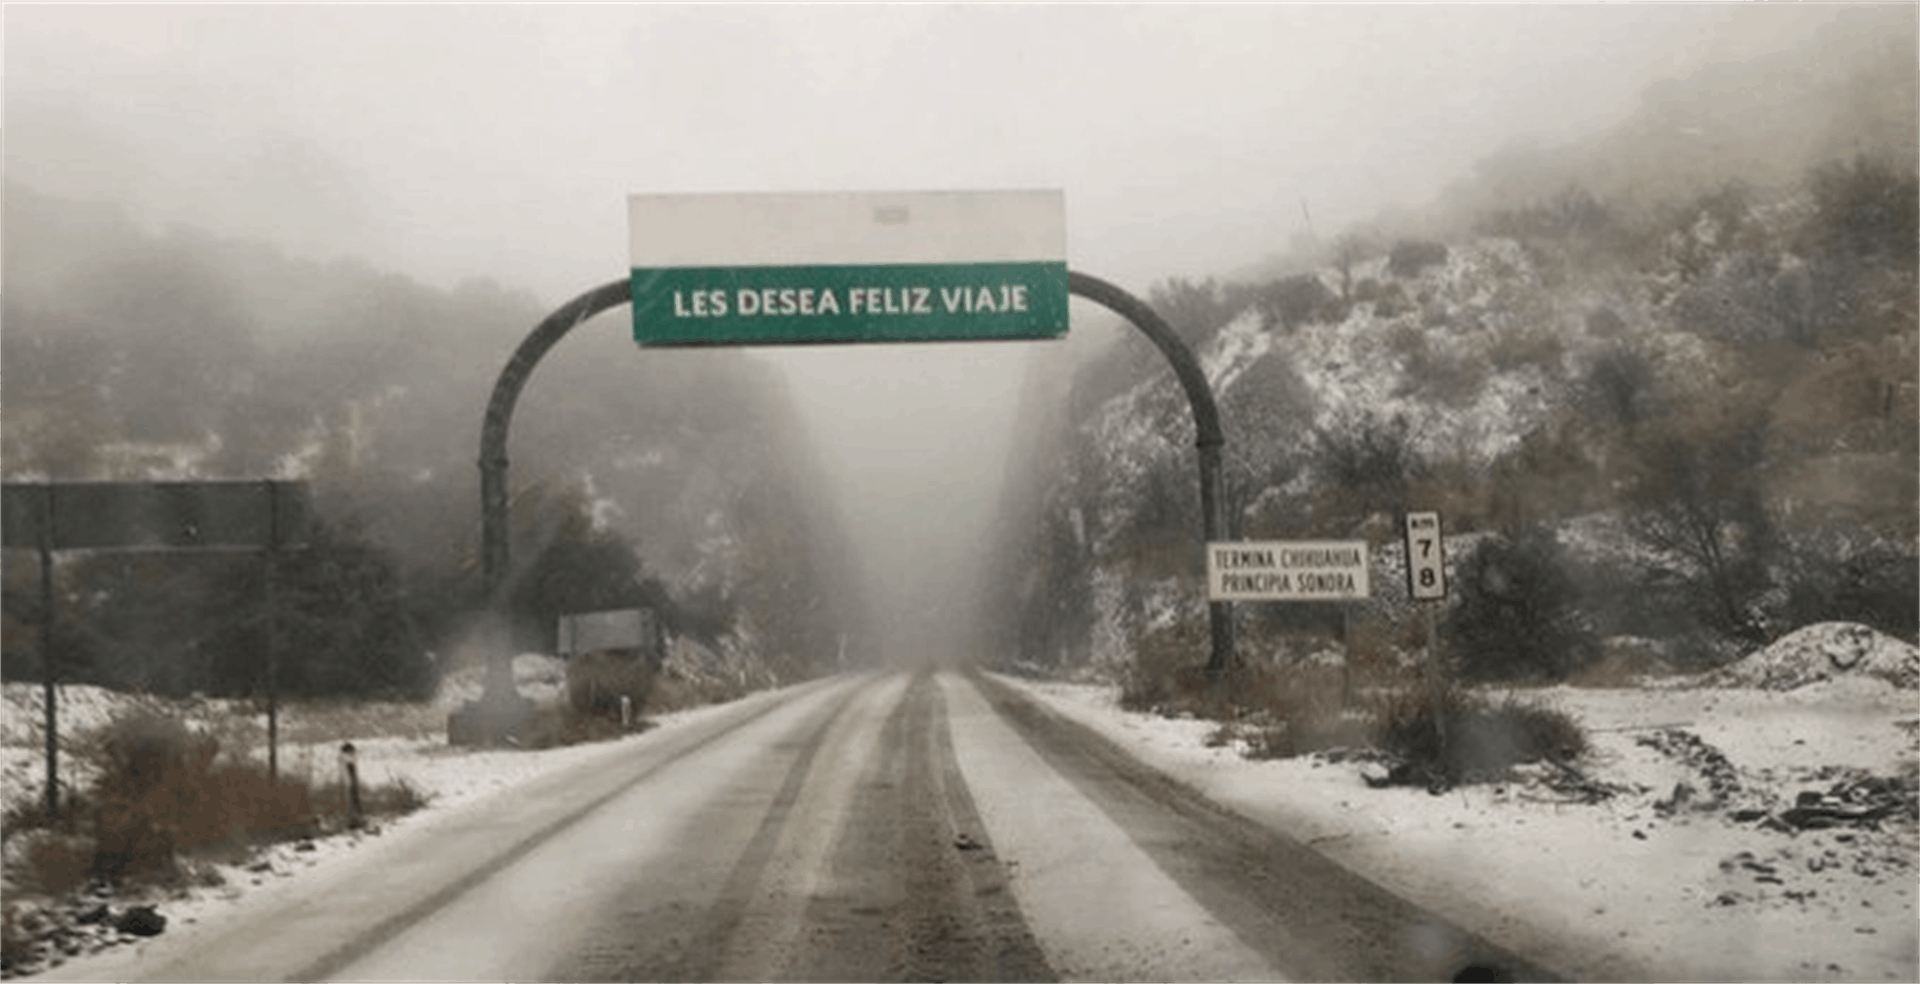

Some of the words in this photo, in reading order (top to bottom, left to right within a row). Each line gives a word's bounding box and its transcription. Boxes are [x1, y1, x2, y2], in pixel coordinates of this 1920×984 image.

[674, 289, 728, 317] LES
[737, 288, 840, 316] DESEA
[849, 286, 931, 315] FELIZ
[940, 284, 1028, 314] VIAJE
[1215, 550, 1275, 568] TERMINA
[1281, 549, 1361, 568] CHIHUAHUA
[1222, 573, 1291, 592] PRINCIPIA
[1297, 572, 1356, 592] SONORA
